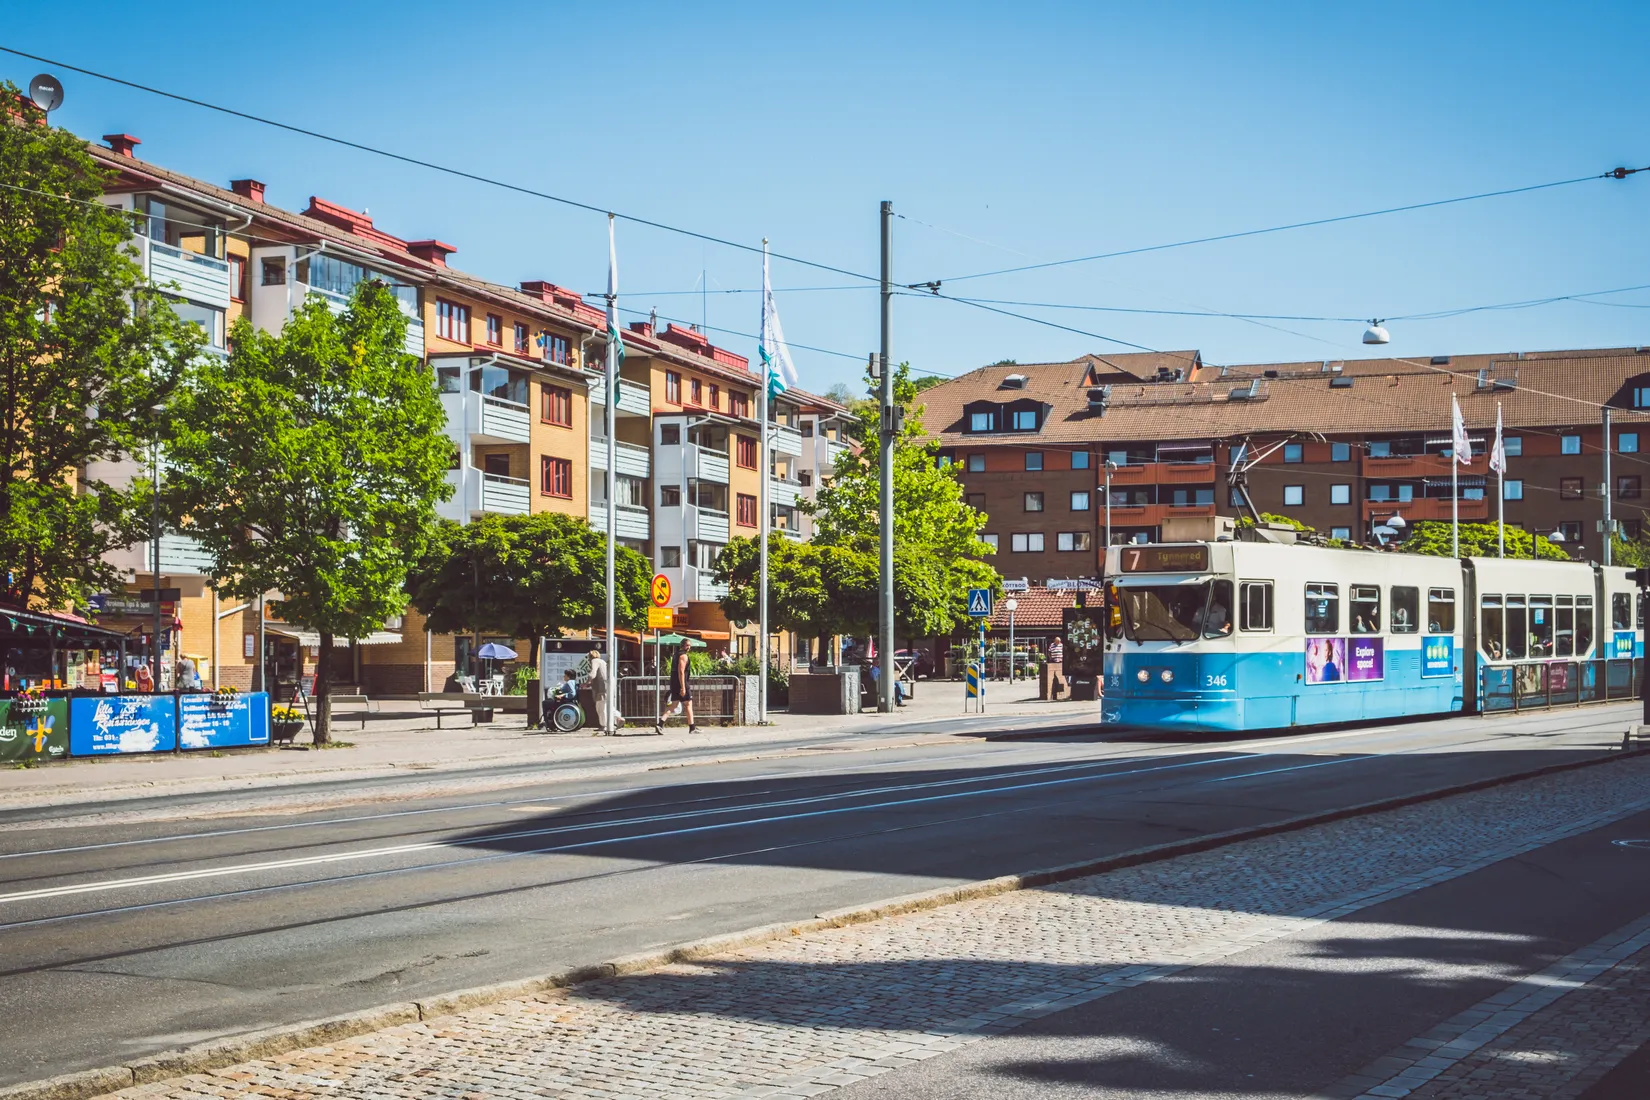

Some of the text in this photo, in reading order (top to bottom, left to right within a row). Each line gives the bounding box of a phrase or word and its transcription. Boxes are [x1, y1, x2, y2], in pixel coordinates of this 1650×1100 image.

[1129, 550, 1141, 571] 7
[1355, 646, 1375, 658] Explore
[1356, 658, 1374, 670] space!
[1206, 675, 1227, 686] 346
